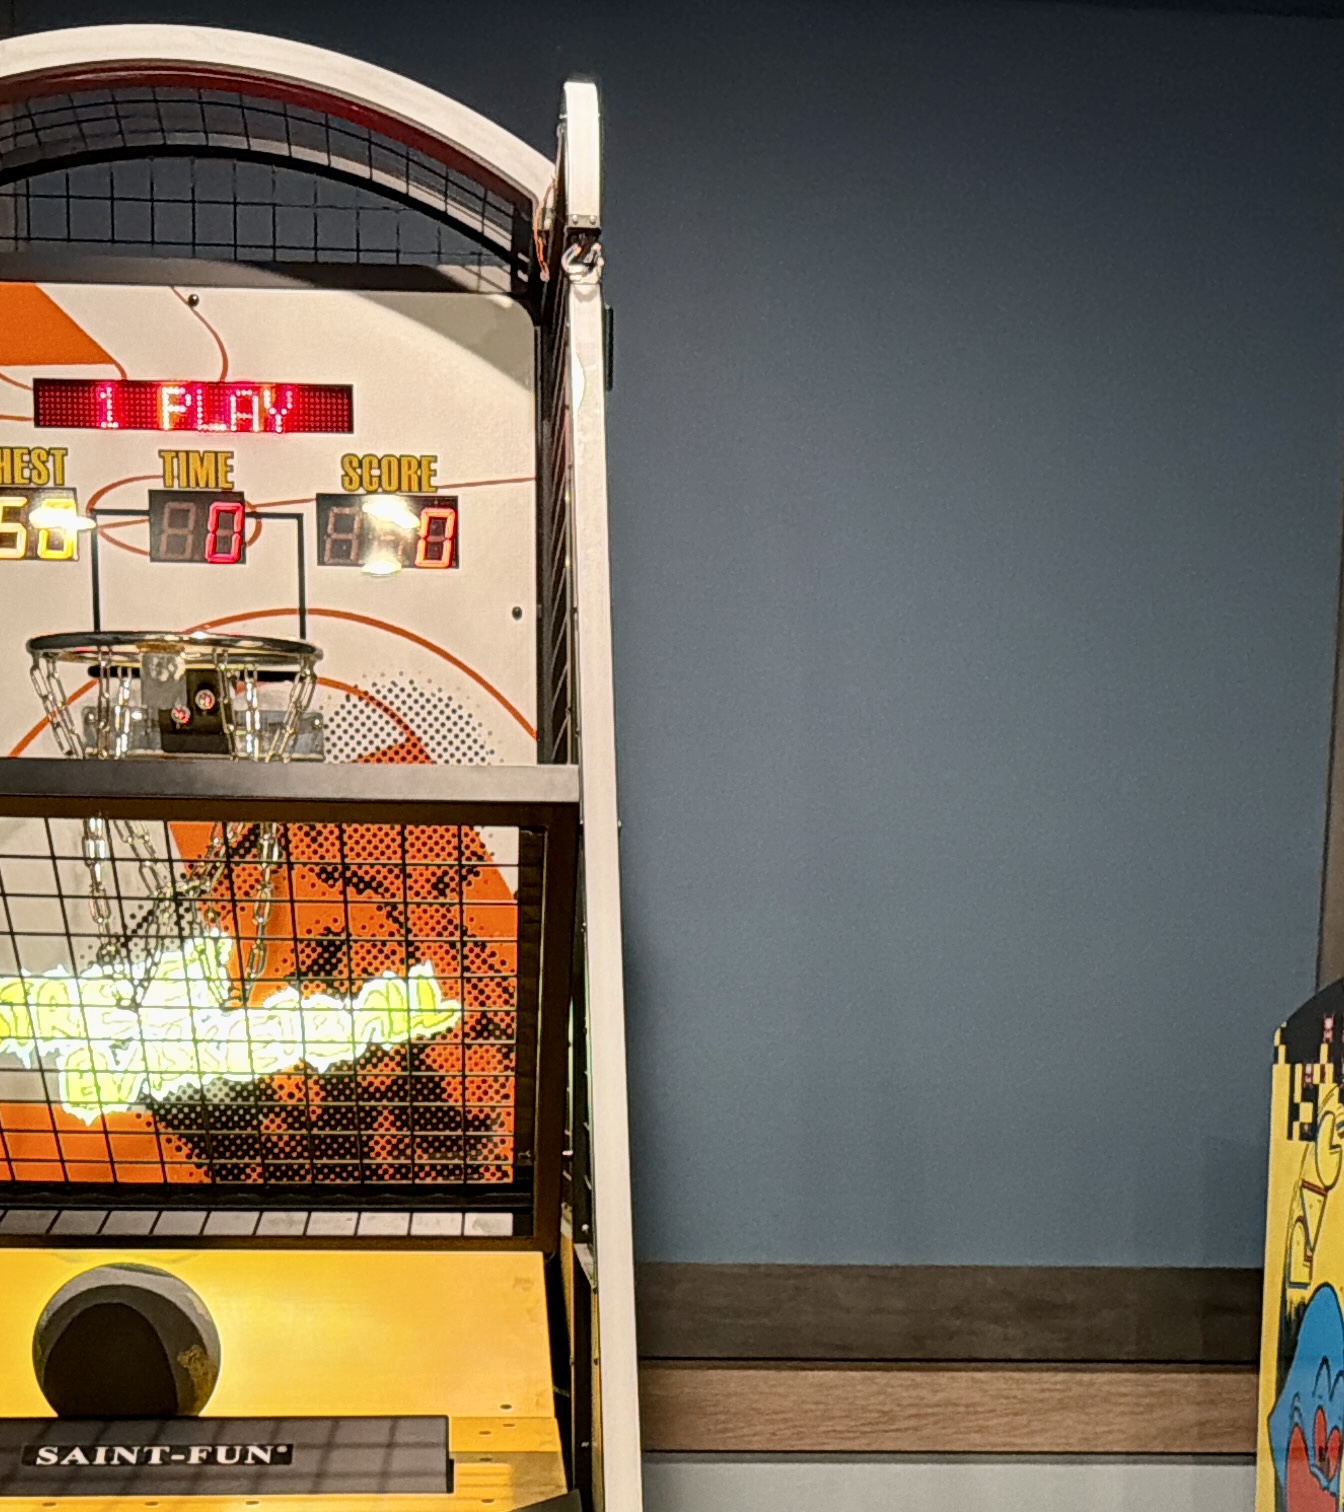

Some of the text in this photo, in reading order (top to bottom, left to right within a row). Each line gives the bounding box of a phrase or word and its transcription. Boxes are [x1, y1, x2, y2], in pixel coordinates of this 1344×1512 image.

[160, 386, 295, 434] PLAY
[158, 450, 235, 490] TIME
[341, 453, 438, 493] SCORE
[36, 1446, 273, 1465] SAINT-FUN
